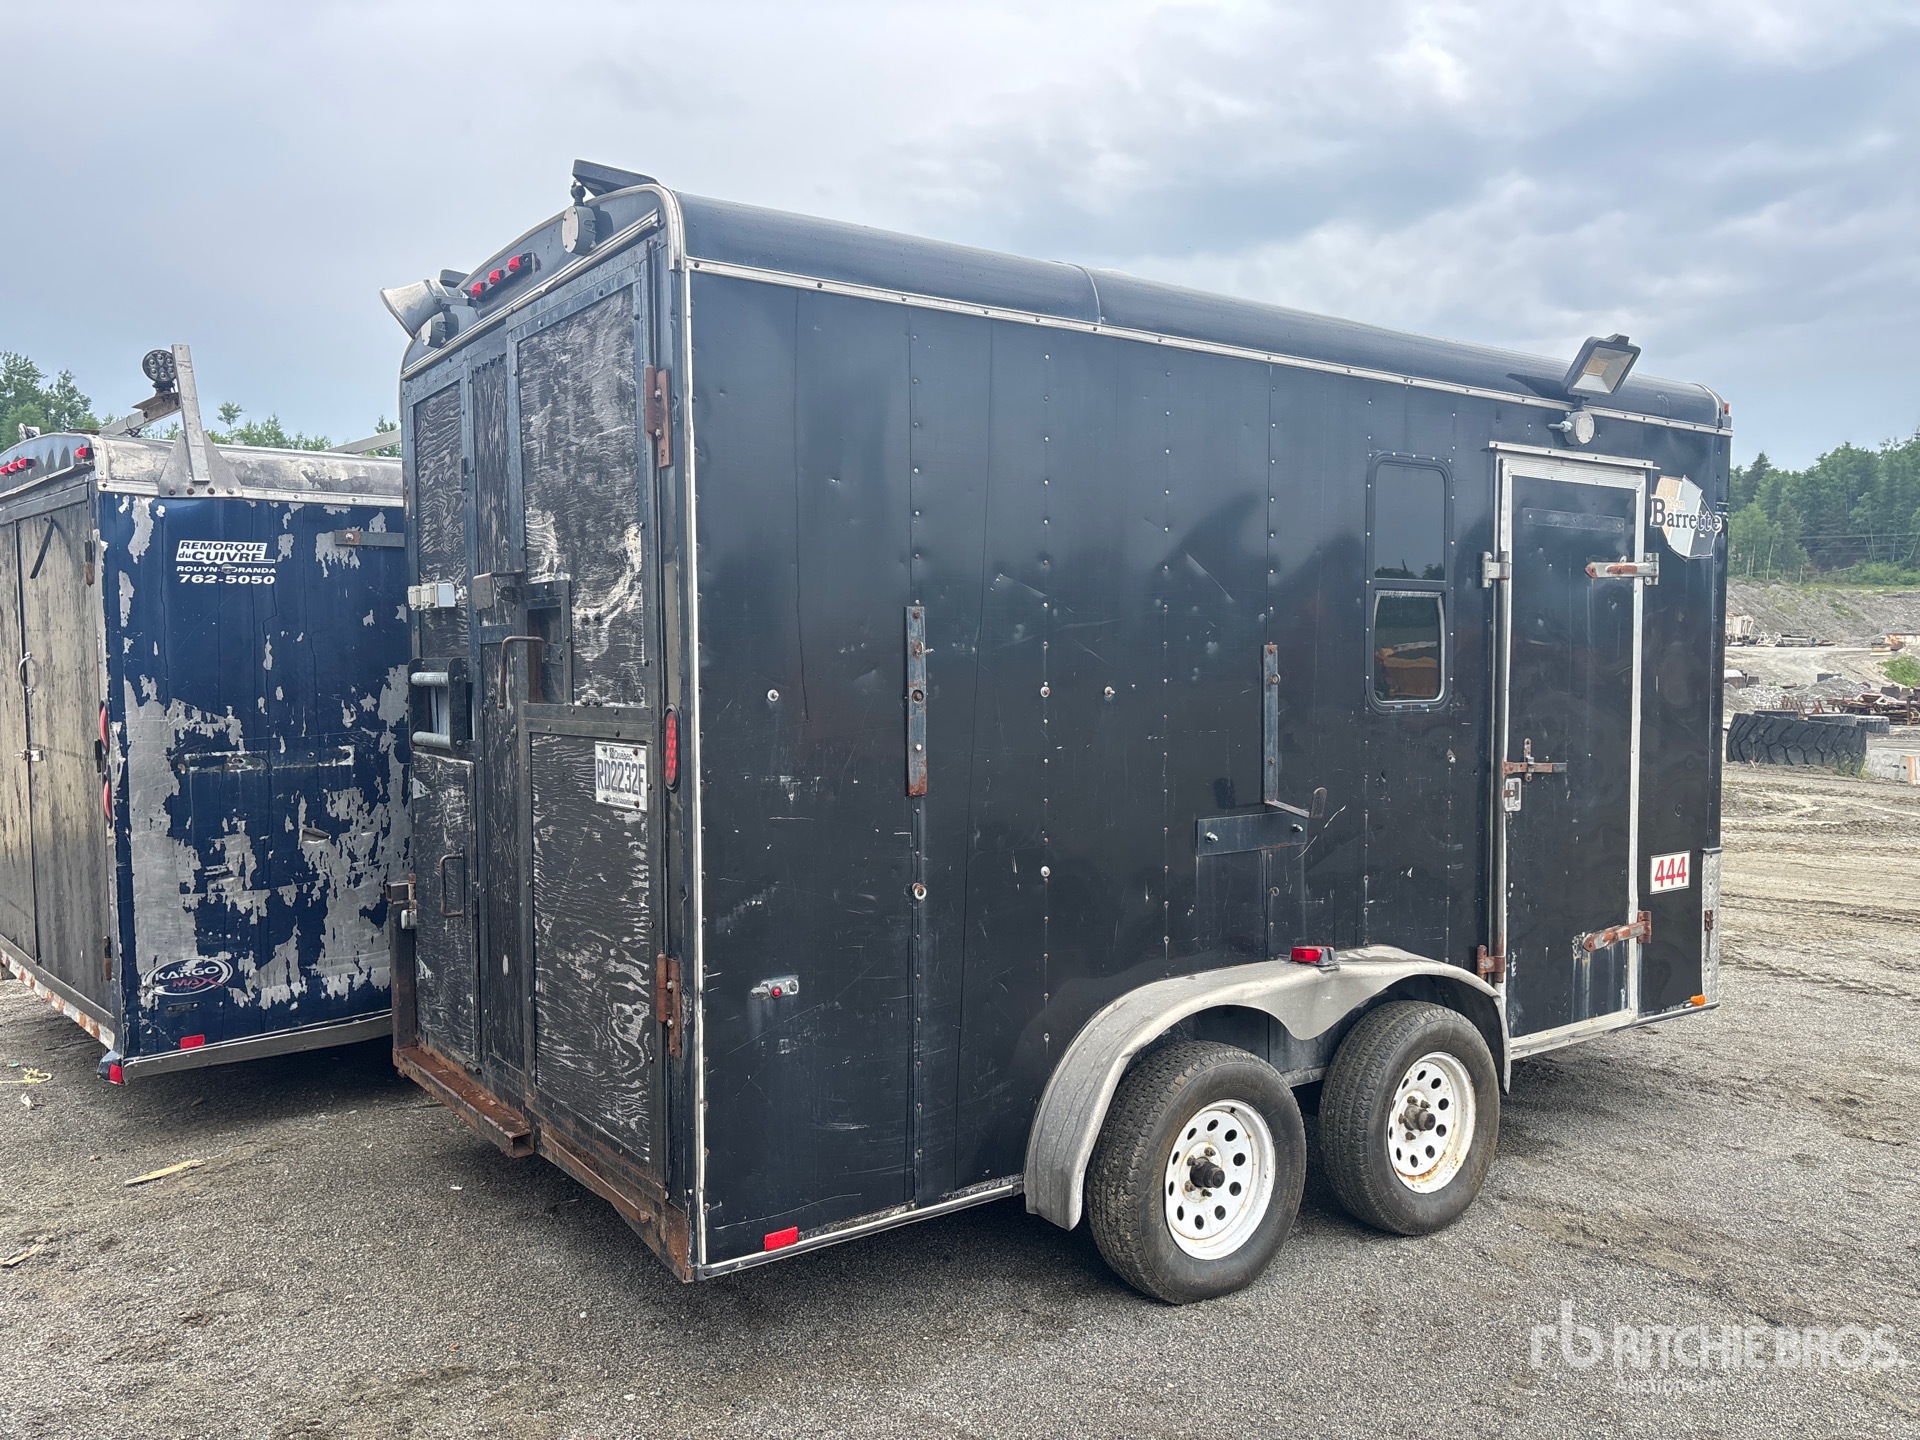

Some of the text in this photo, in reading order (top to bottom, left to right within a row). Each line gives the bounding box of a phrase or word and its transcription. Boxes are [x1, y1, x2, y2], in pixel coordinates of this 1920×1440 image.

[1650, 497, 1721, 531] Barrette
[180, 542, 265, 552] REMORQUE
[178, 551, 262, 562] du CUIVRE
[179, 574, 276, 585] 762-5050
[597, 758, 646, 796] RD2232F
[1654, 856, 1687, 887] 444
[155, 966, 219, 981] KARGO
[172, 972, 224, 990] MAX
